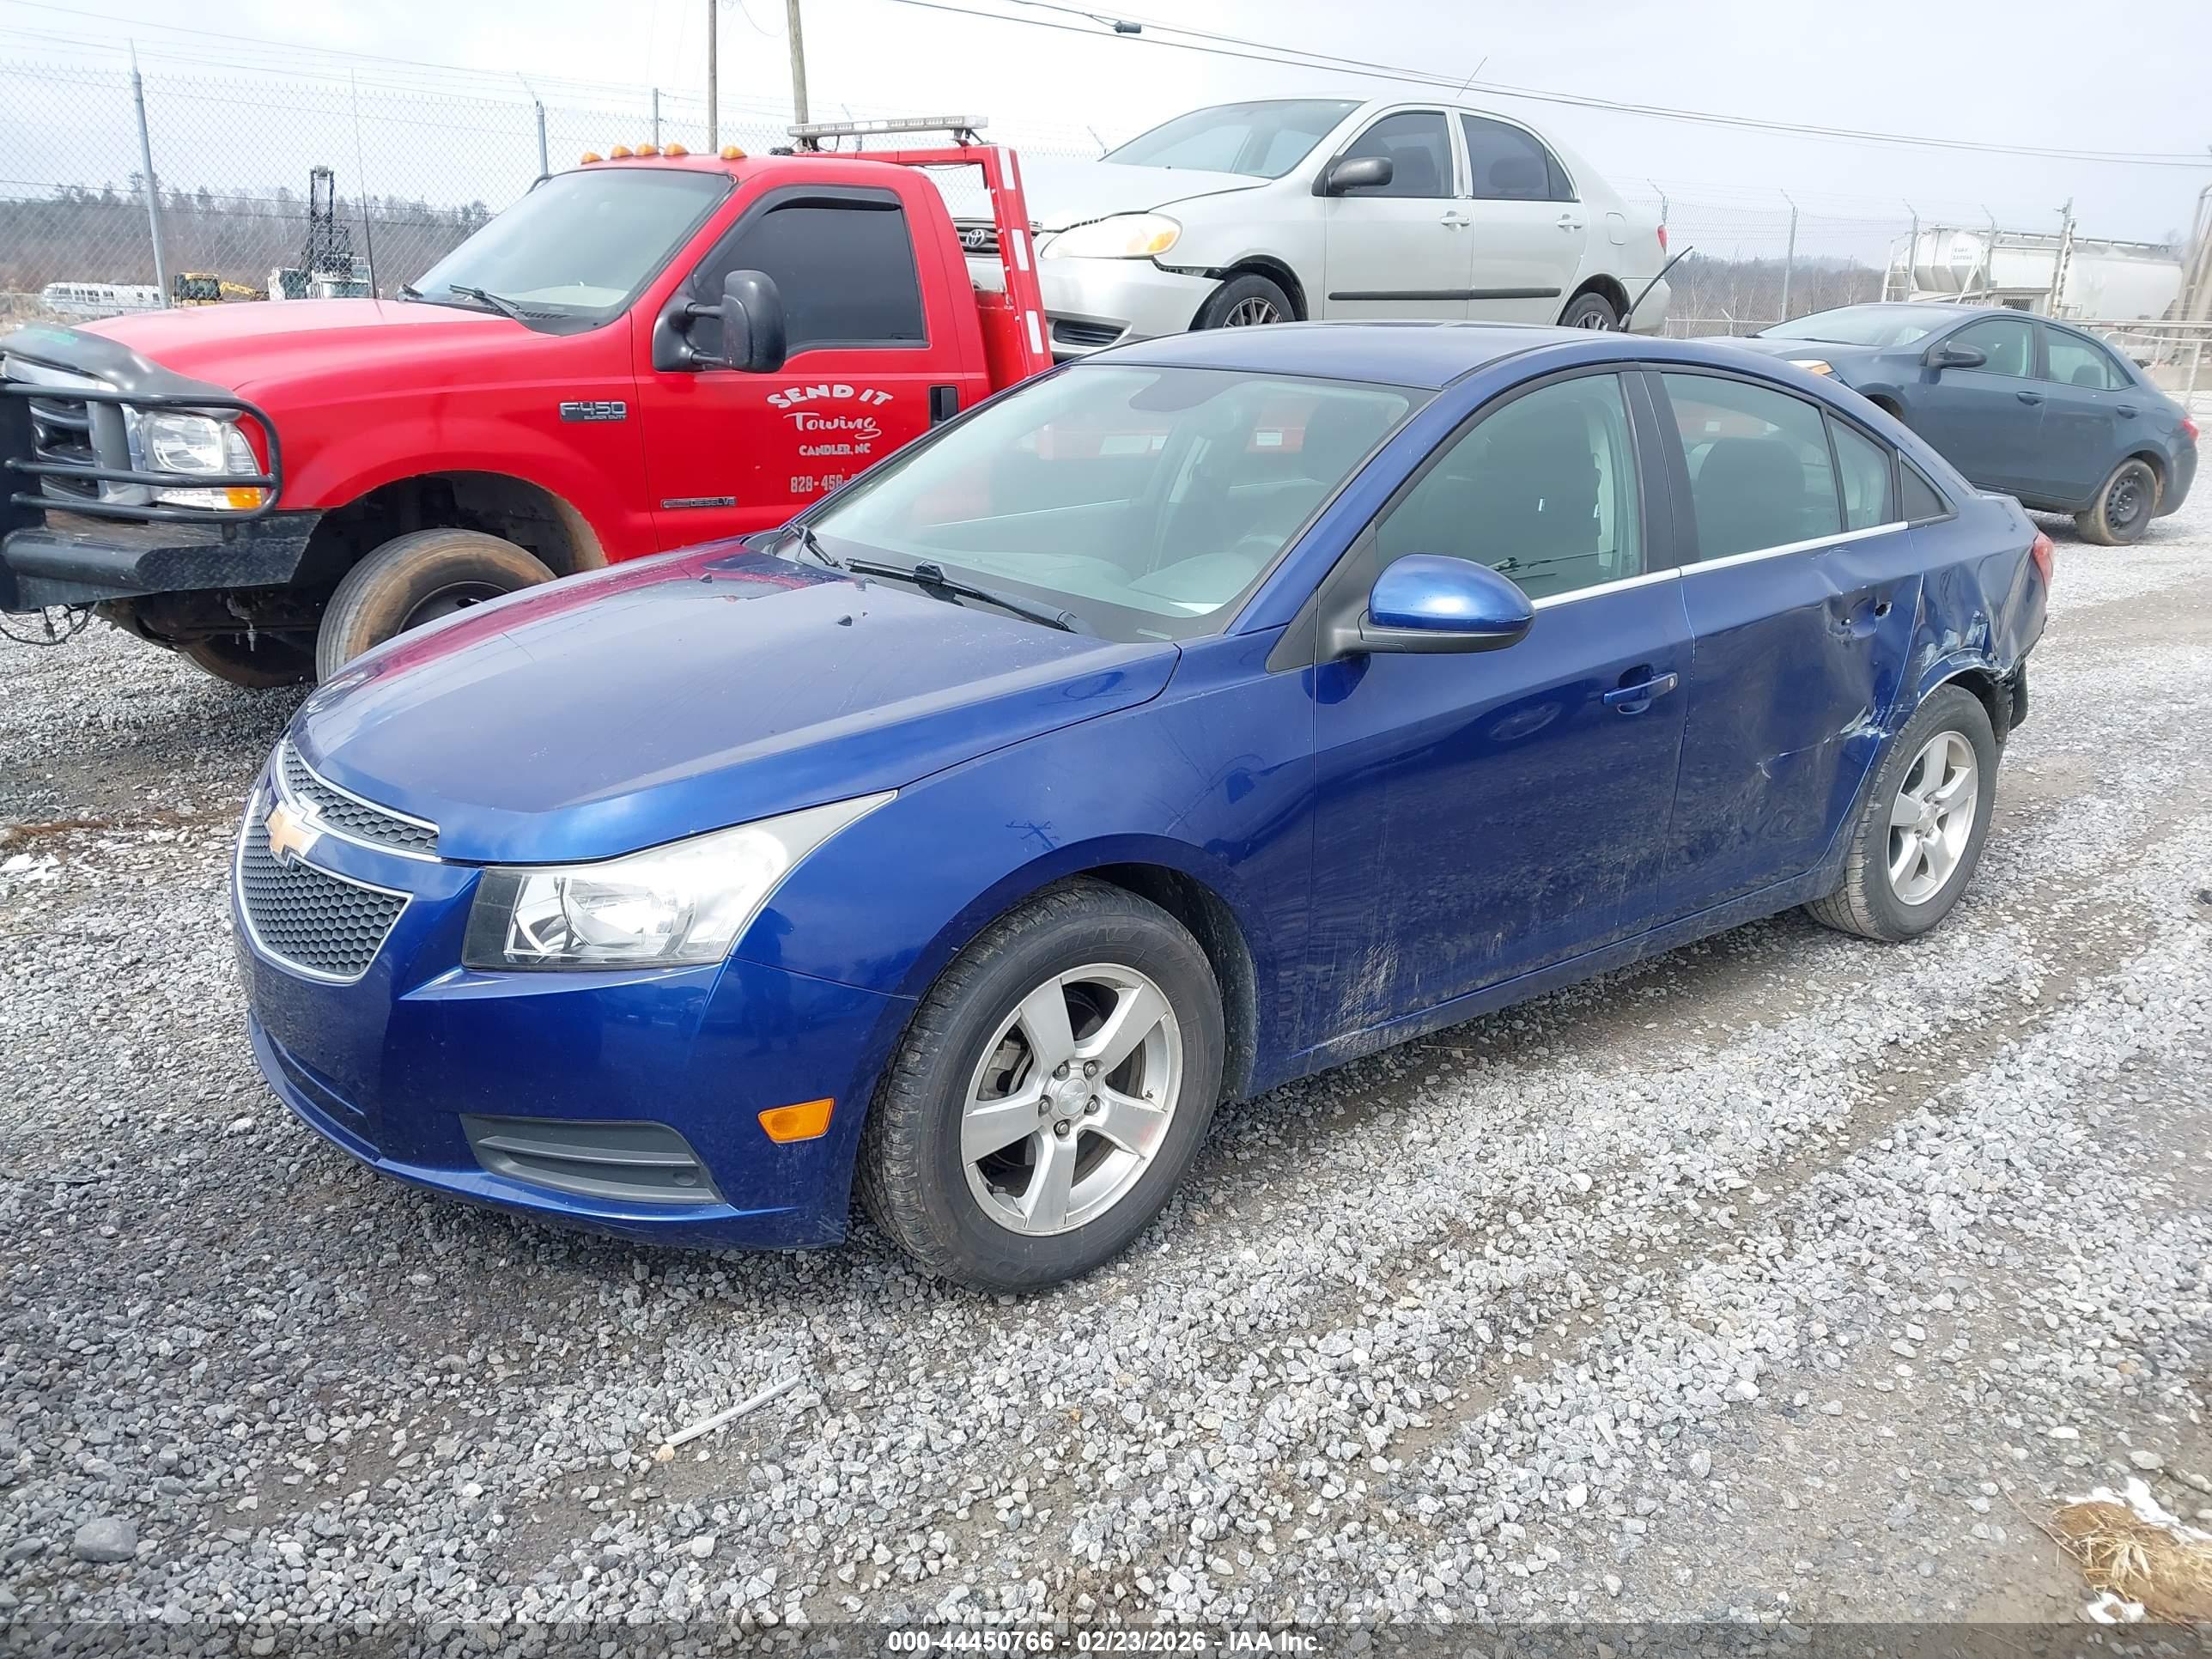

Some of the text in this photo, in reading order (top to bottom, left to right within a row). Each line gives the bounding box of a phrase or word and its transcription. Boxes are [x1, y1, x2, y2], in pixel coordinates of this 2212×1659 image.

[767, 384, 894, 409] SEND IT
[560, 401, 626, 416] F-450
[783, 412, 882, 440] Towing
[799, 443, 871, 455] CANDLER, NC
[790, 473, 859, 493] 828-458-
